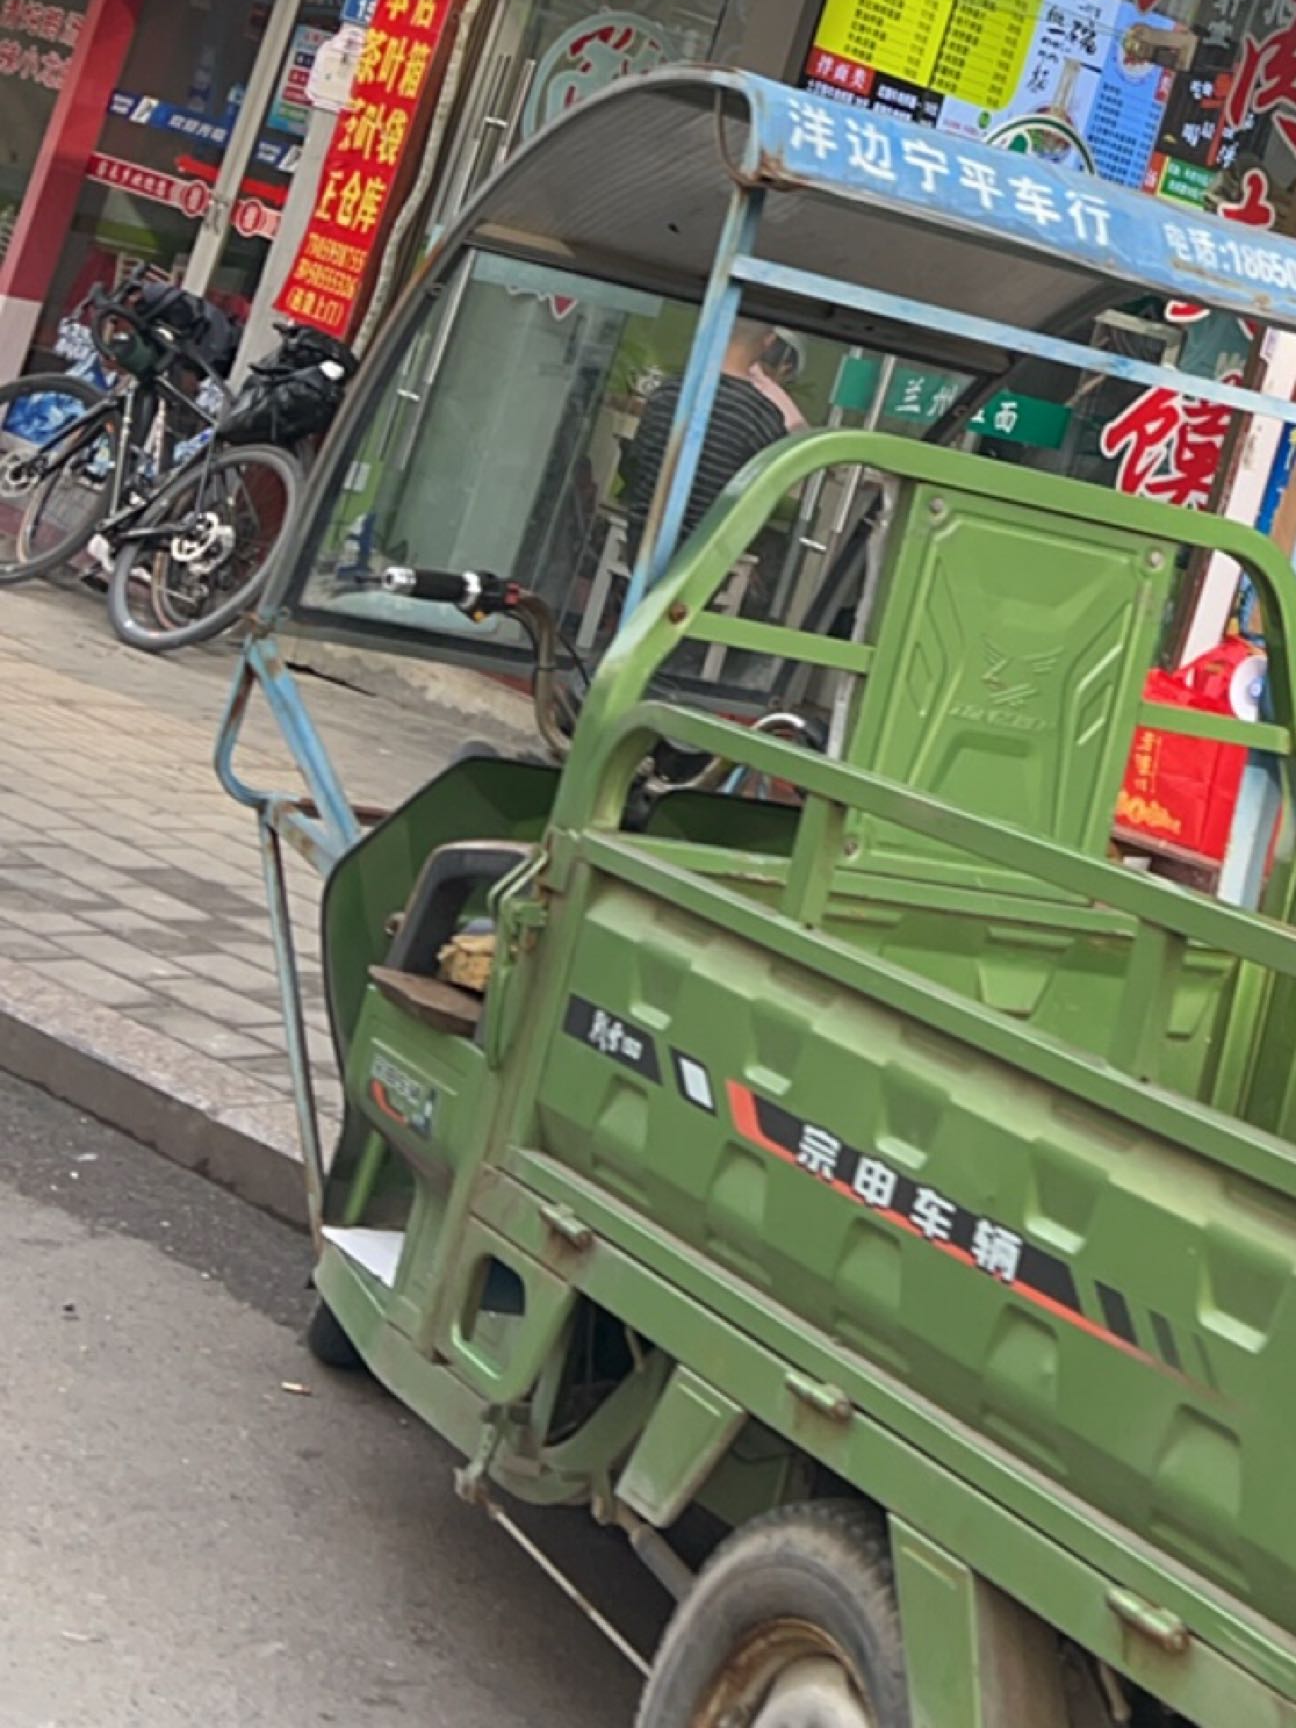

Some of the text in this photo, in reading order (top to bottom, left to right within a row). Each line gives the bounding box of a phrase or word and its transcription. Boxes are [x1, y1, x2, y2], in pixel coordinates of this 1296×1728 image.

[786, 100, 1113, 248] 洋边宁平车行
[797, 1124, 1023, 1282] 宗申车辆
